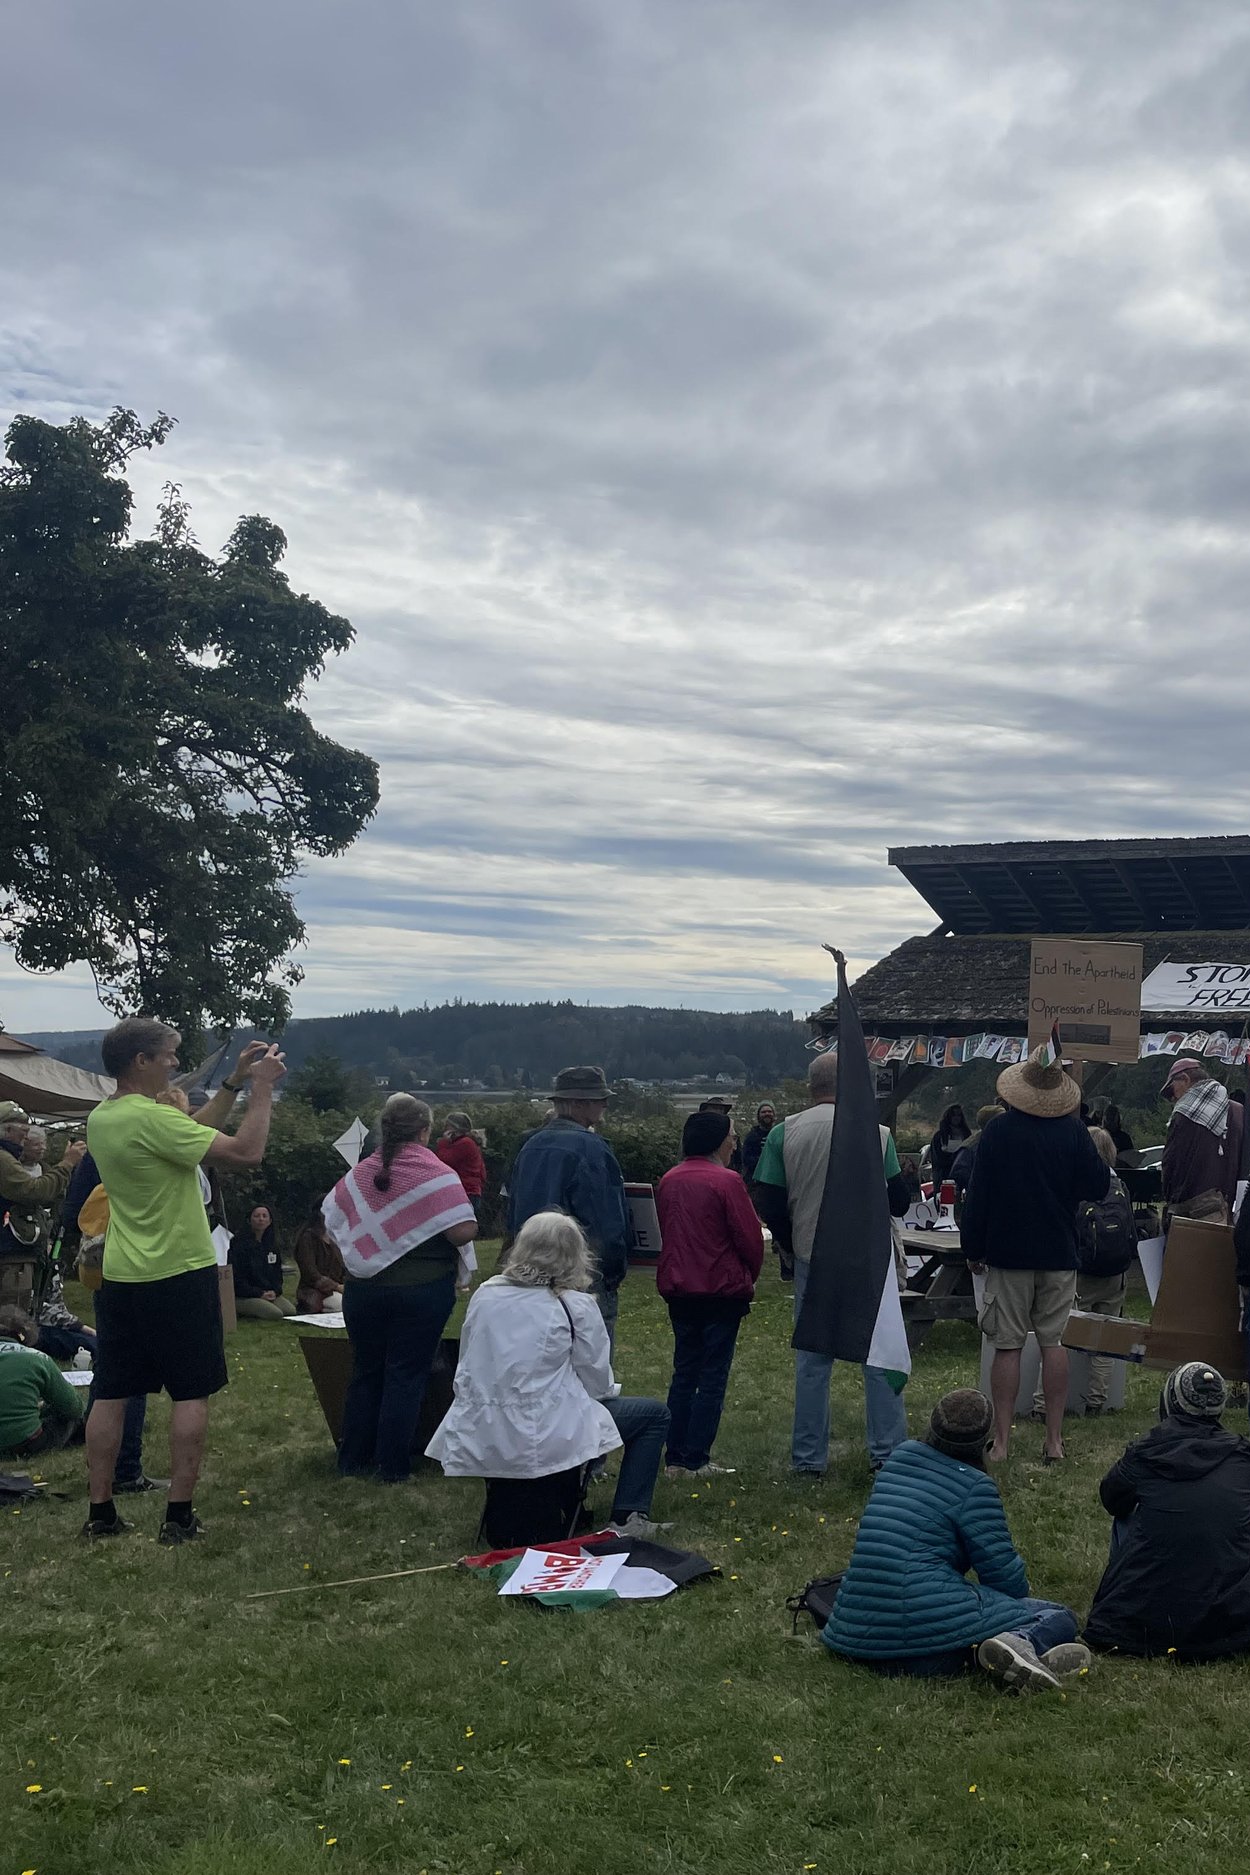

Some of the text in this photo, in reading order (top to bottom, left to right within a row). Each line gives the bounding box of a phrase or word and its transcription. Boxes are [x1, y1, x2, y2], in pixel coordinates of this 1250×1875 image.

[1034, 957, 1057, 975] End
[1084, 960, 1136, 982] Apartheid
[1031, 997, 1085, 1019] Oppression
[1086, 1003, 1095, 1015] of
